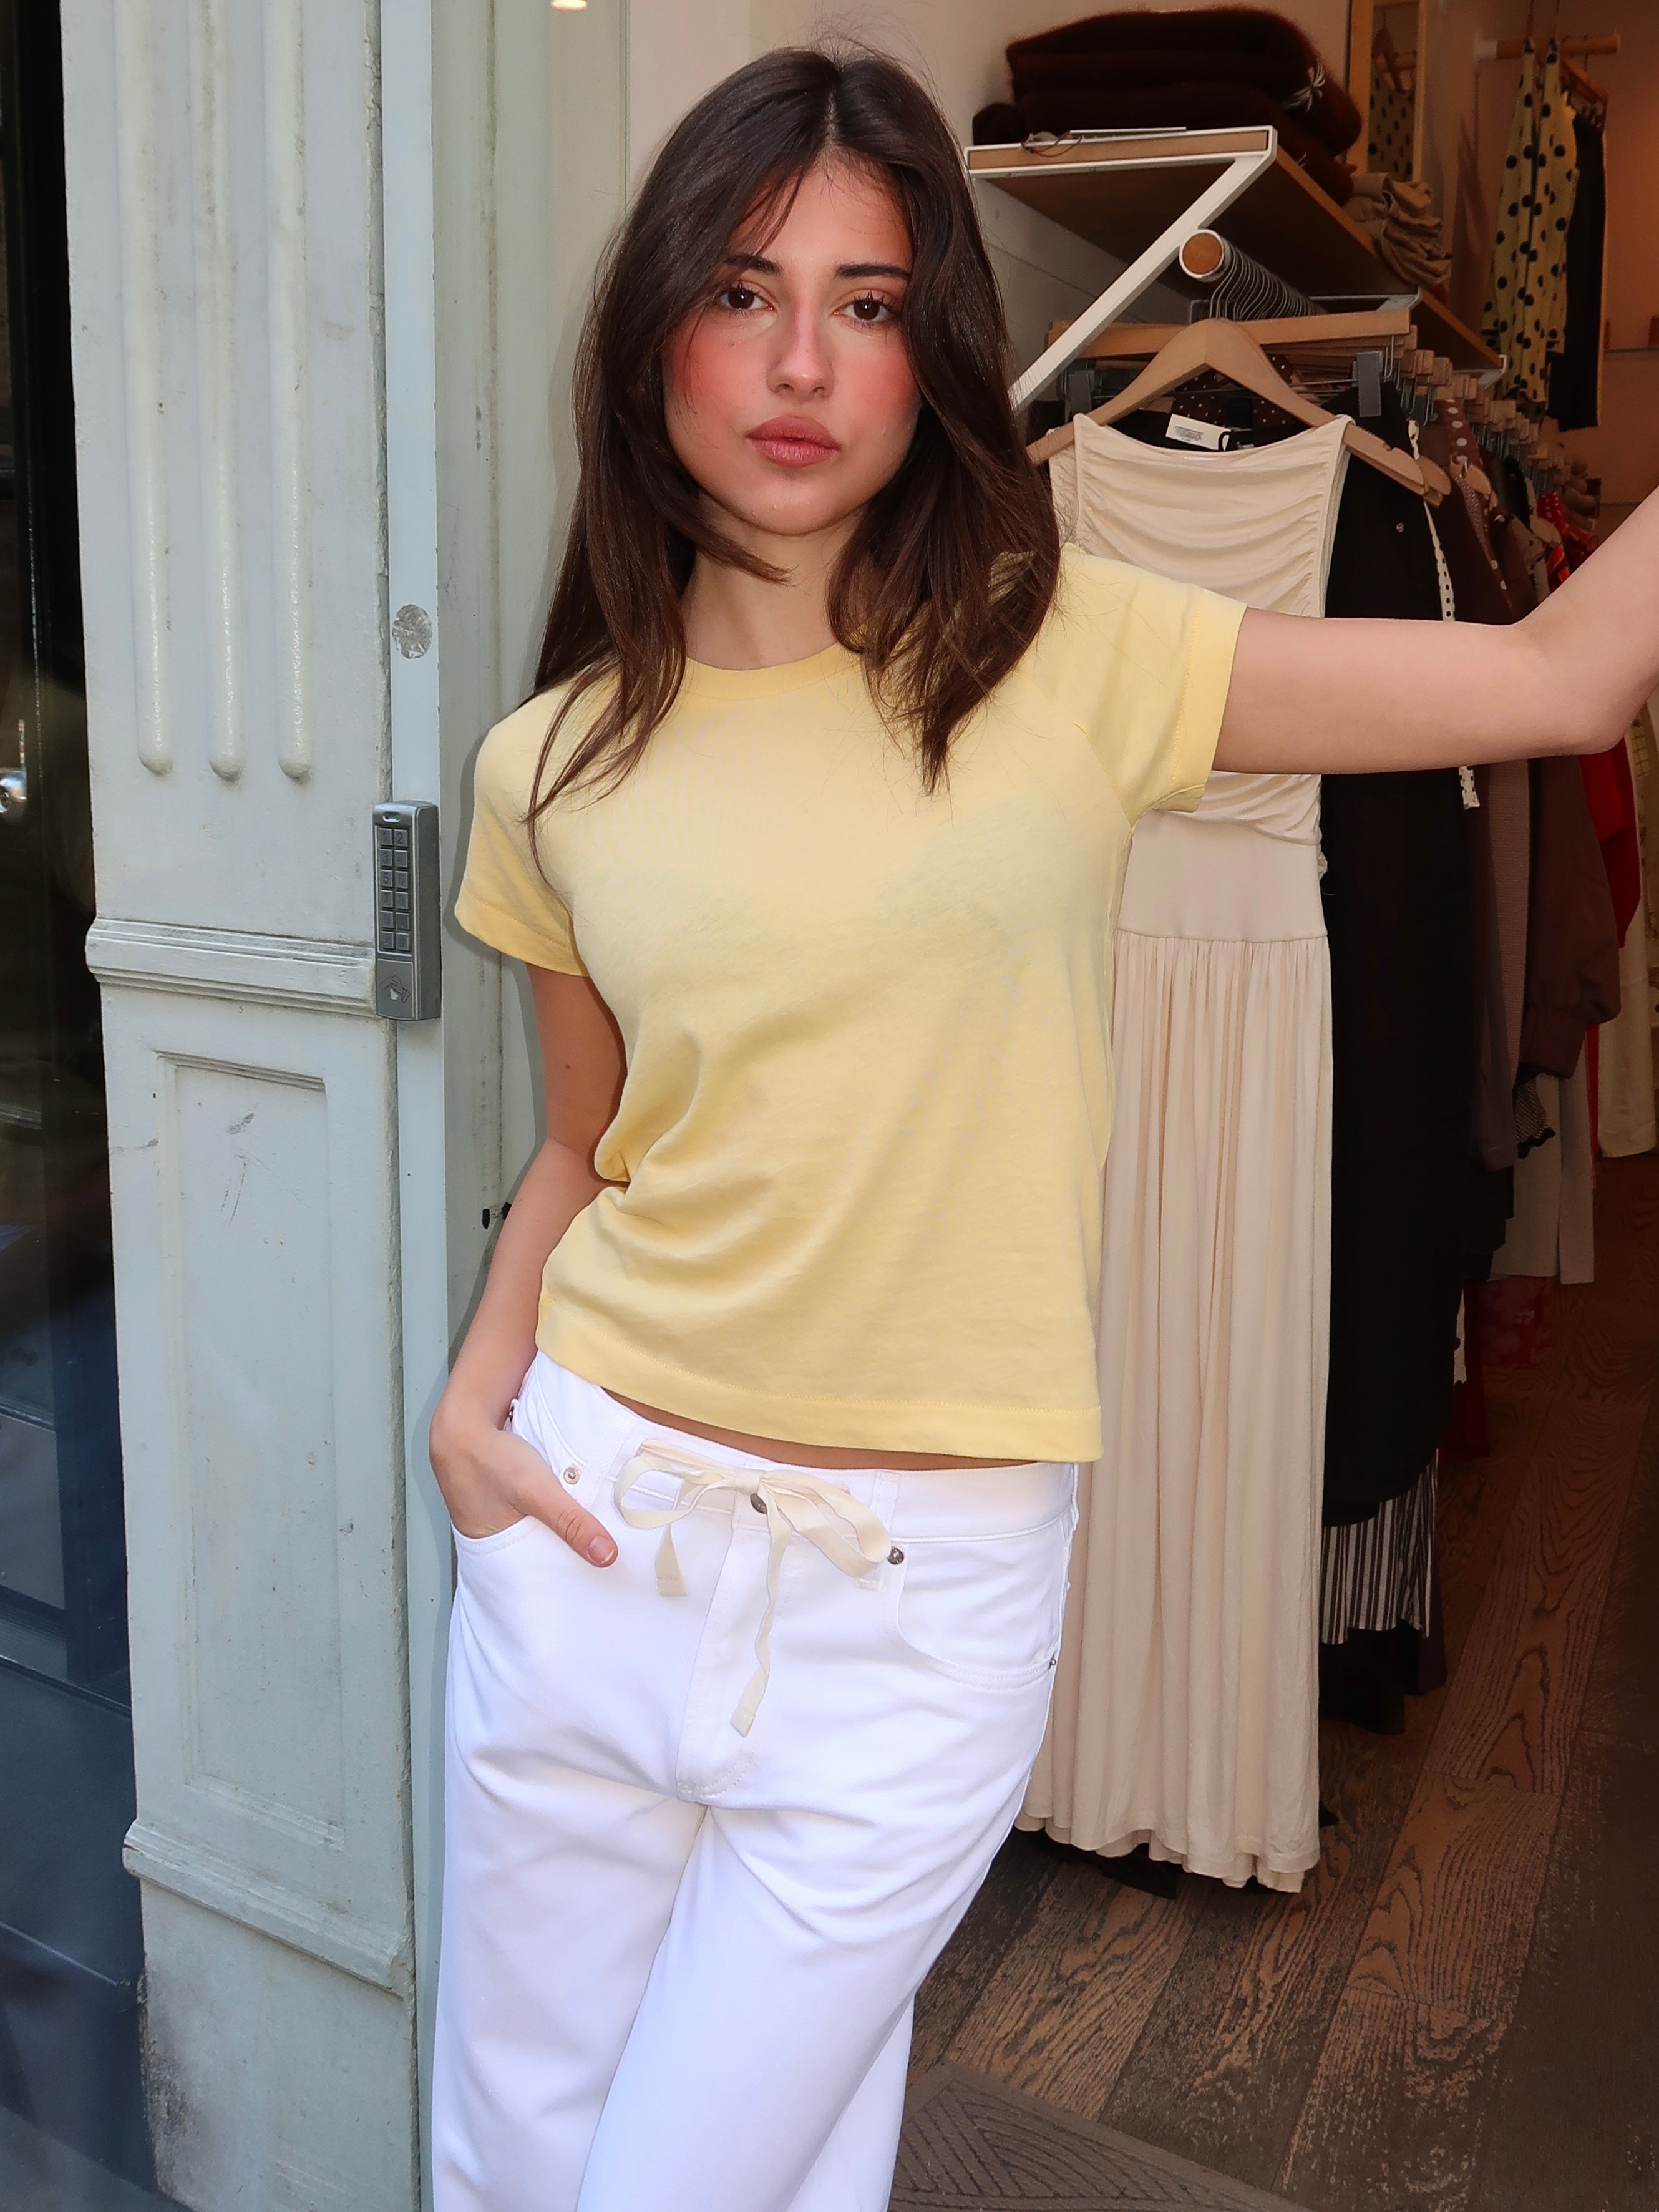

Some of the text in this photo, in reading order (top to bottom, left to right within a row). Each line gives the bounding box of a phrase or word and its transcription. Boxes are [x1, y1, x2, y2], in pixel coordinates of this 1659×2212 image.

[397, 831, 403, 844] 2
[381, 852, 389, 864] 3
[382, 872, 405, 886] 5 6
